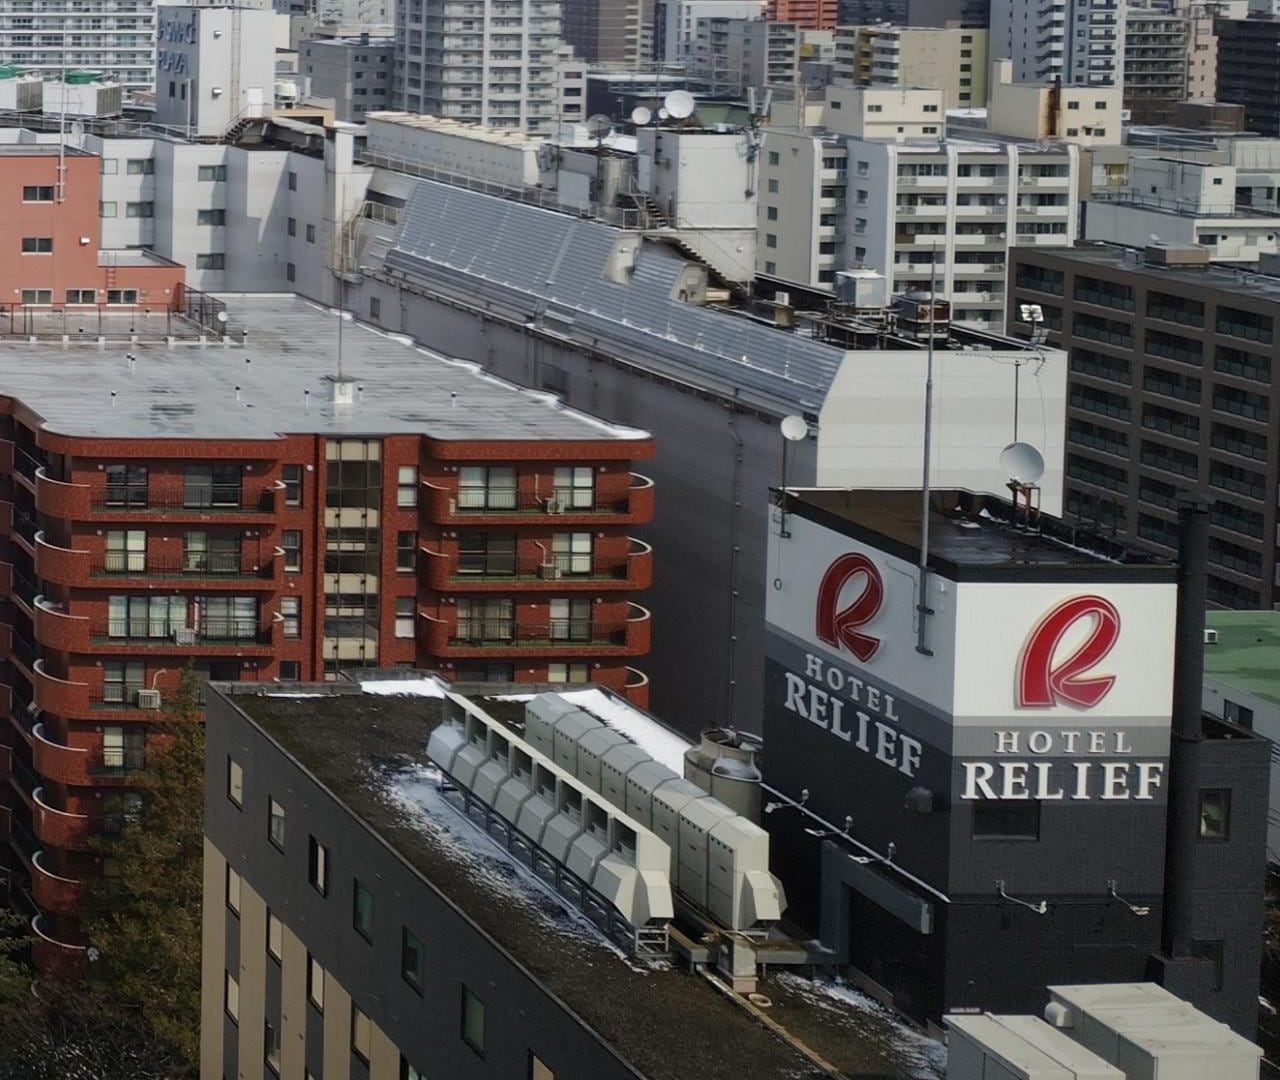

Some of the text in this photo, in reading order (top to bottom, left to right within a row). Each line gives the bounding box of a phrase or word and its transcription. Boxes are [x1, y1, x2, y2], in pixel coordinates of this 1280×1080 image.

[805, 653, 900, 722] HOTEL
[784, 671, 923, 779] RELIEF
[995, 730, 1132, 754] HOTEL
[960, 761, 1164, 801] RELIEF
